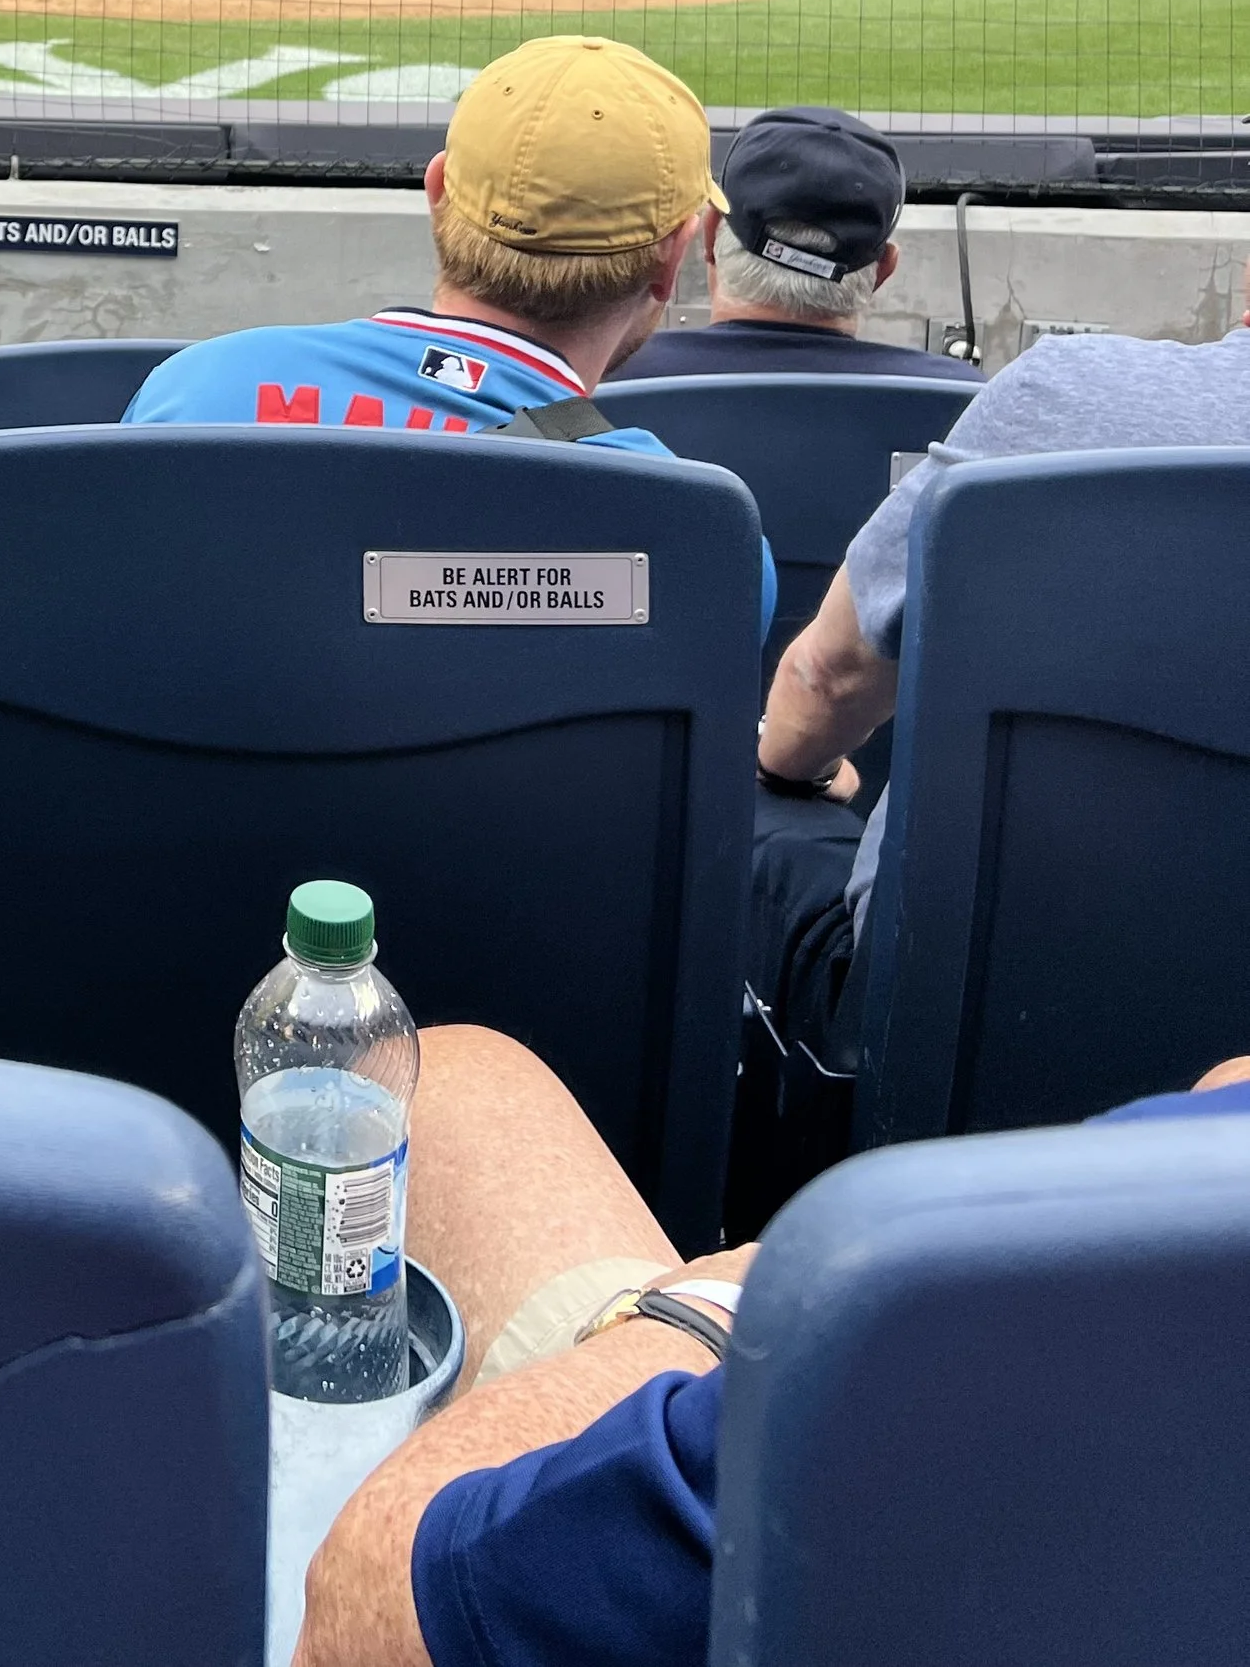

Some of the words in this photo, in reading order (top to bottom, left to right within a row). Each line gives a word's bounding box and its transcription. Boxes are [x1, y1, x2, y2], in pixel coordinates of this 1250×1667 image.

[25, 222, 109, 246] AND/OR
[112, 226, 176, 248] BALLS
[442, 567, 467, 586] BE
[472, 568, 532, 587] ALERT
[536, 568, 572, 587] FOR
[409, 589, 458, 609] BATS
[462, 589, 542, 611] AND/OR
[547, 590, 605, 609] BALLS
[259, 1157, 280, 1180] Facts
